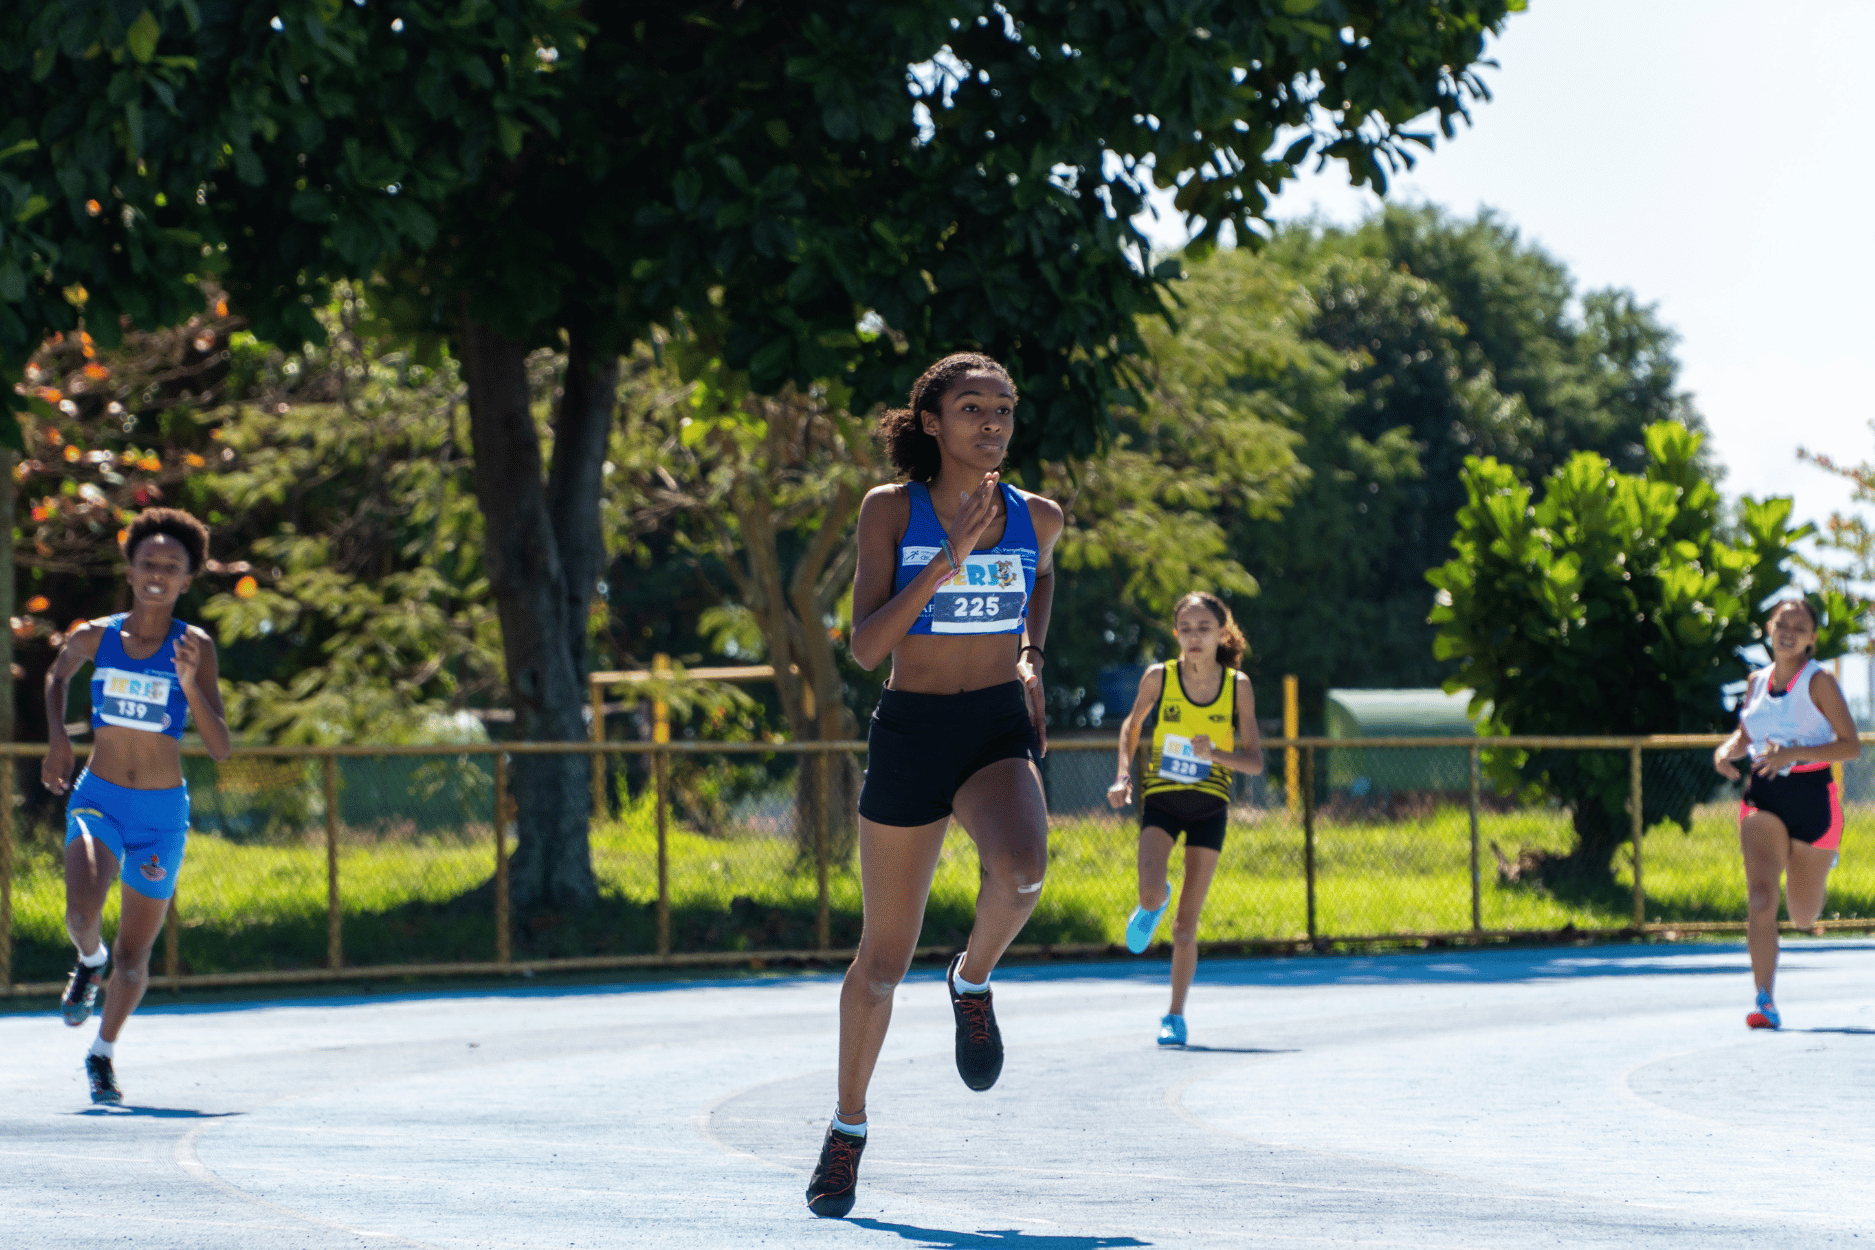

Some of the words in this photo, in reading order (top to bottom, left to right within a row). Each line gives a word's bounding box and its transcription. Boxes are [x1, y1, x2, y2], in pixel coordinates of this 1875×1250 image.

[941, 564, 1000, 586] ERJ
[954, 597, 1000, 617] 225
[117, 700, 148, 719] 139
